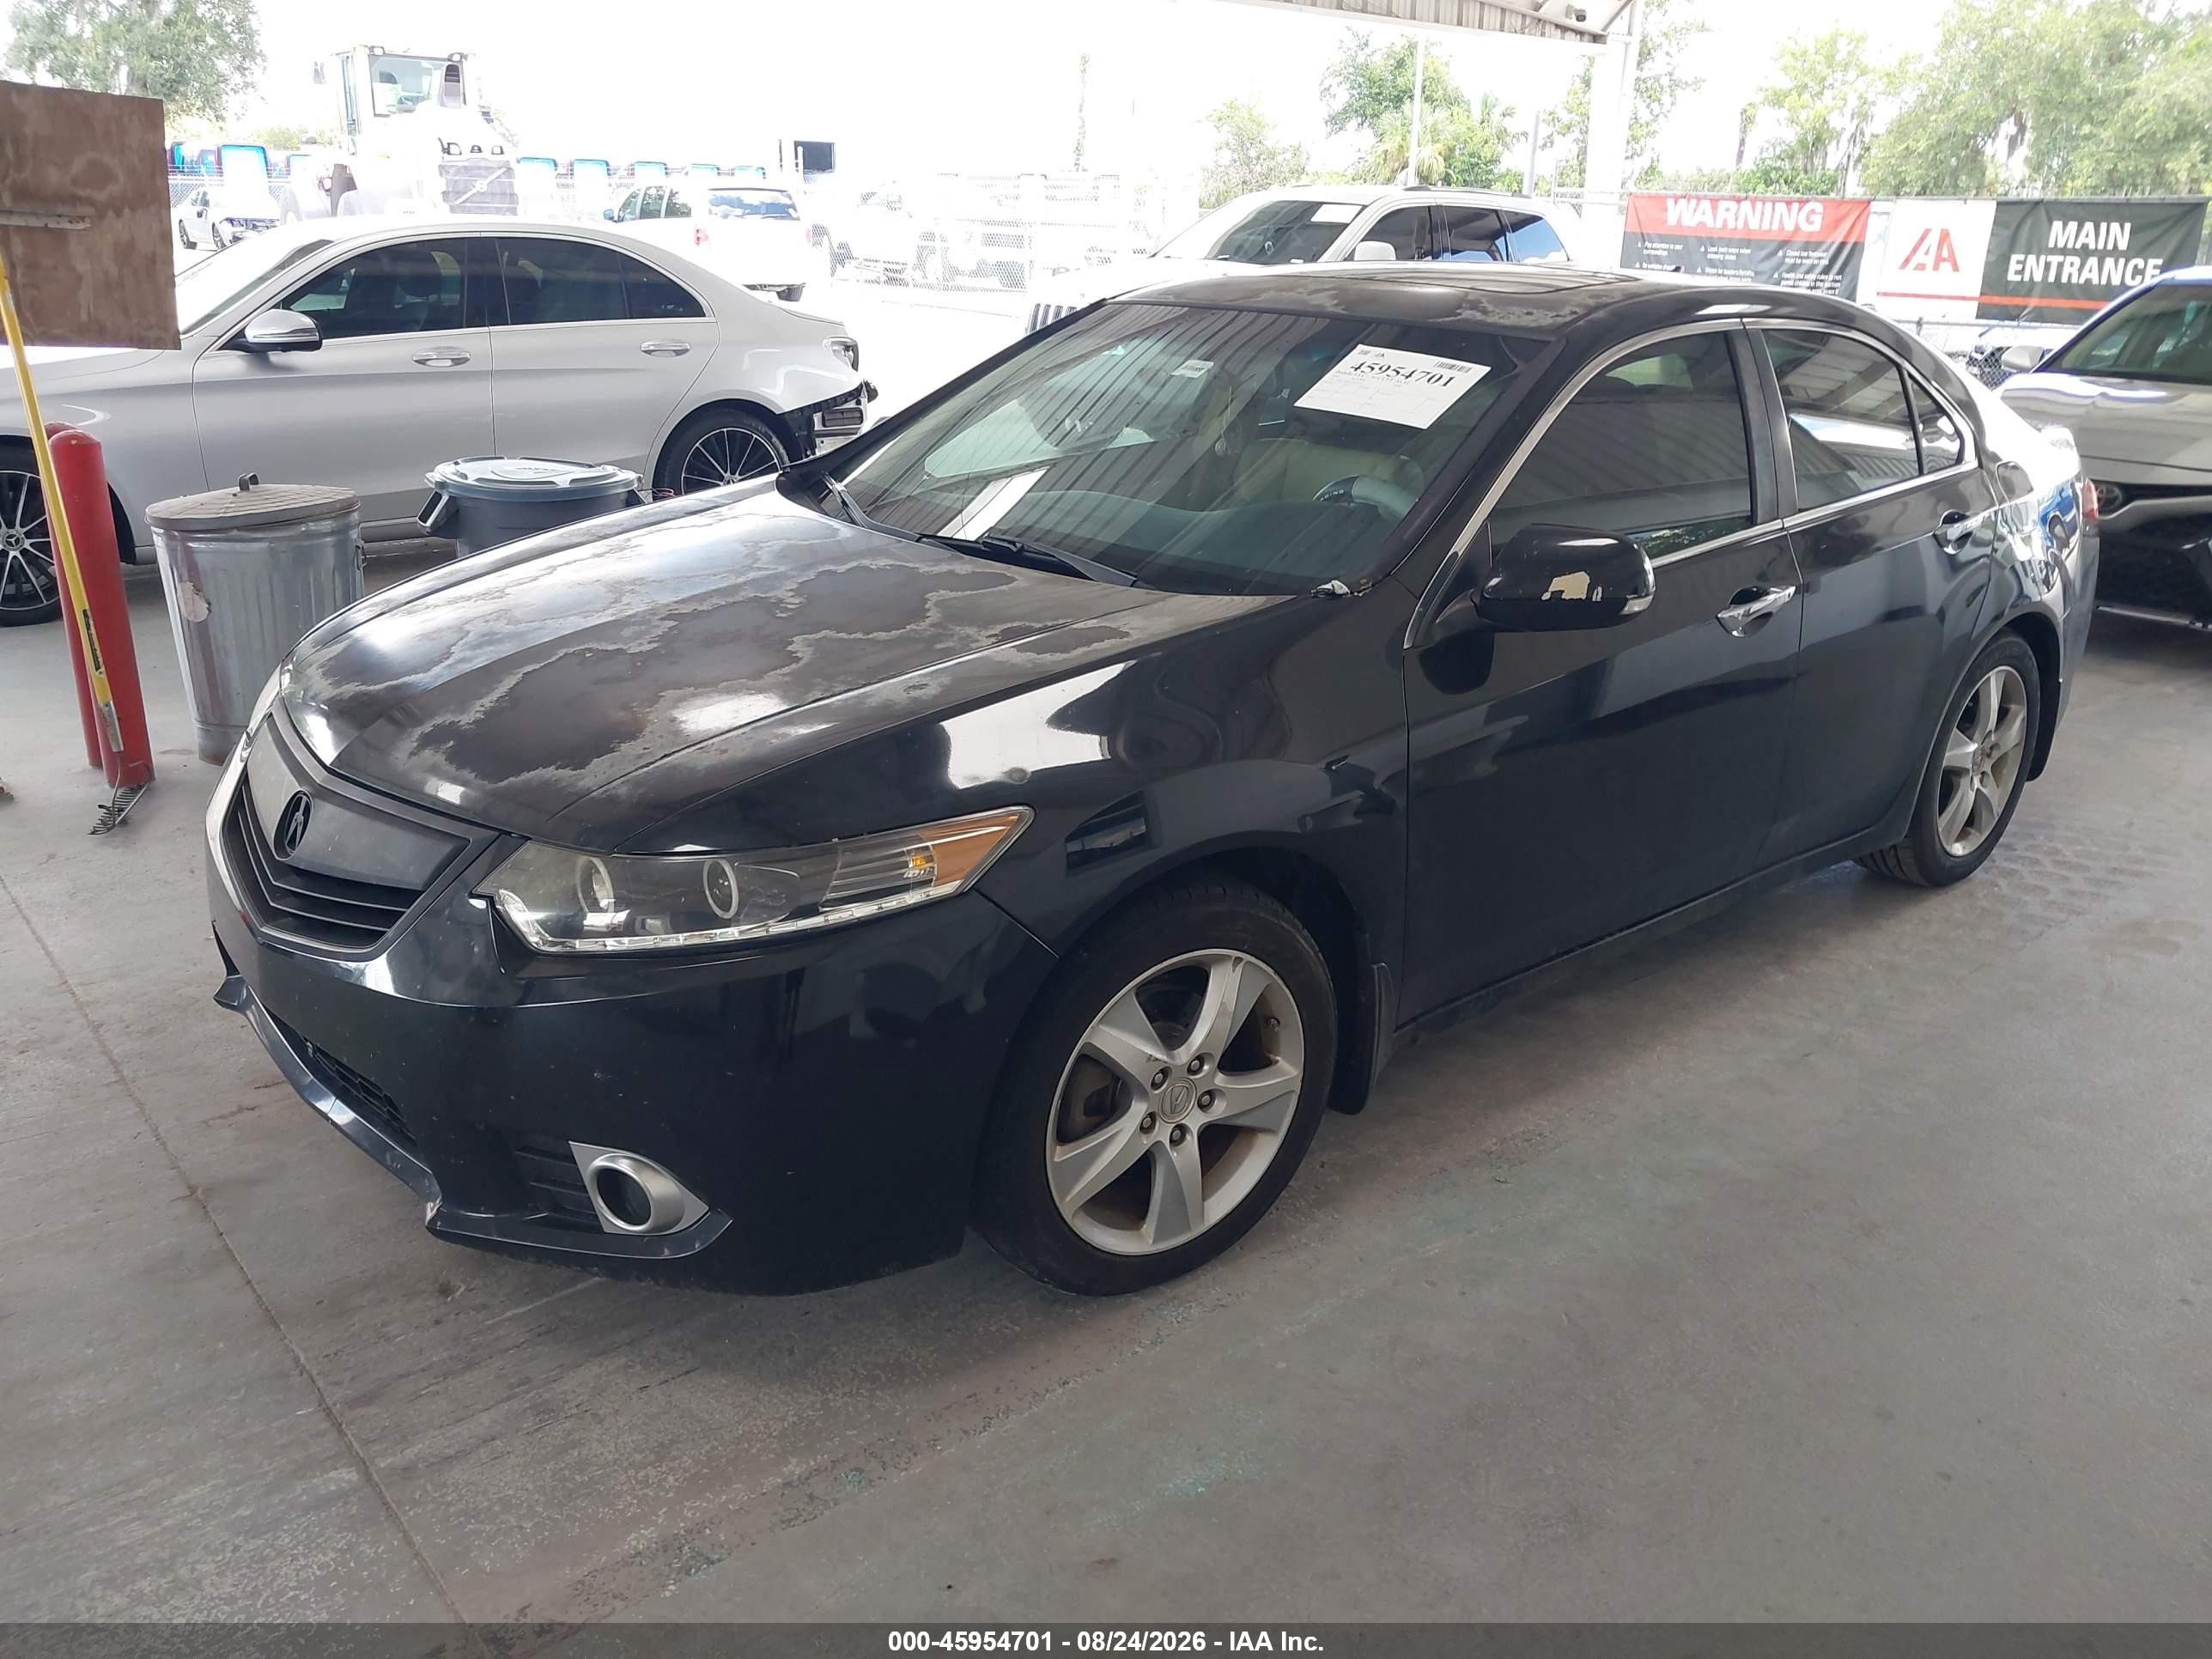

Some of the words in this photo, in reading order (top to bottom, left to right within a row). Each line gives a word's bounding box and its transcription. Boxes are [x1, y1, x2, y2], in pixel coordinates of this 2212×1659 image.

[1666, 197, 1824, 233] WARNING
[2048, 220, 2131, 251] MAIN
[2007, 254, 2164, 287] ENTRANCE
[1350, 361, 1457, 387] 45954701
